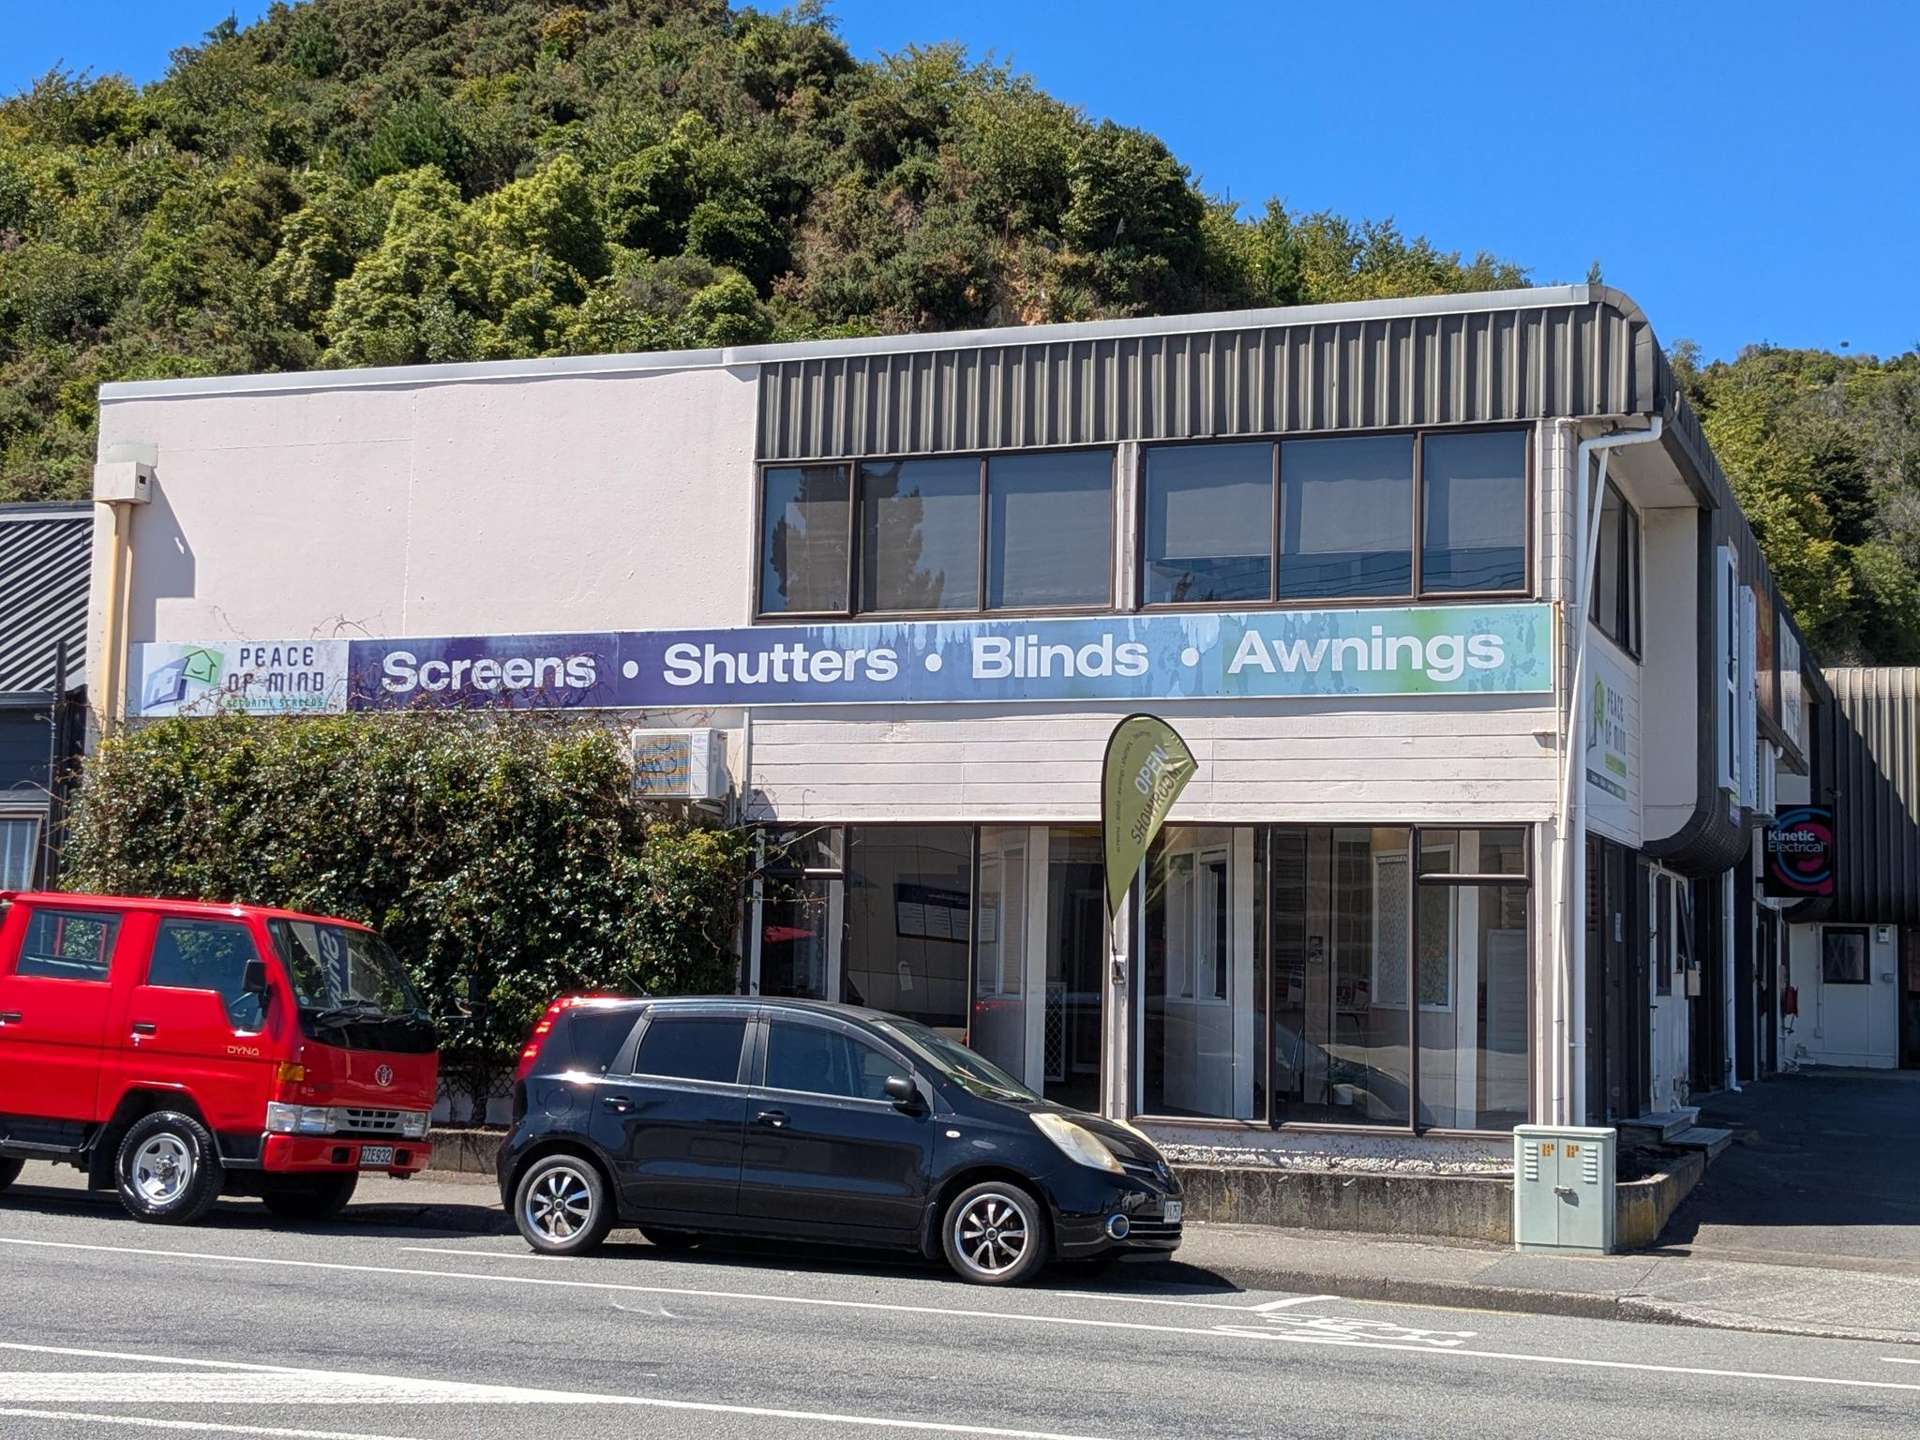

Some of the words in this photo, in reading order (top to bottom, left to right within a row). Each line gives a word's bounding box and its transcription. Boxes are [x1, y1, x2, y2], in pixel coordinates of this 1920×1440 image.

[240, 646, 314, 668] PEACE
[382, 651, 596, 693] Screens
[663, 642, 899, 686] Shutters
[972, 633, 1150, 679] Blinds
[1227, 625, 1505, 682] Awnings
[228, 673, 255, 693] OF
[268, 672, 324, 693] MIND
[1135, 744, 1169, 795] OPEN
[1131, 766, 1183, 845] SHOWROOM
[1768, 830, 1816, 841] Kinetic
[1768, 841, 1824, 852] Electrical
